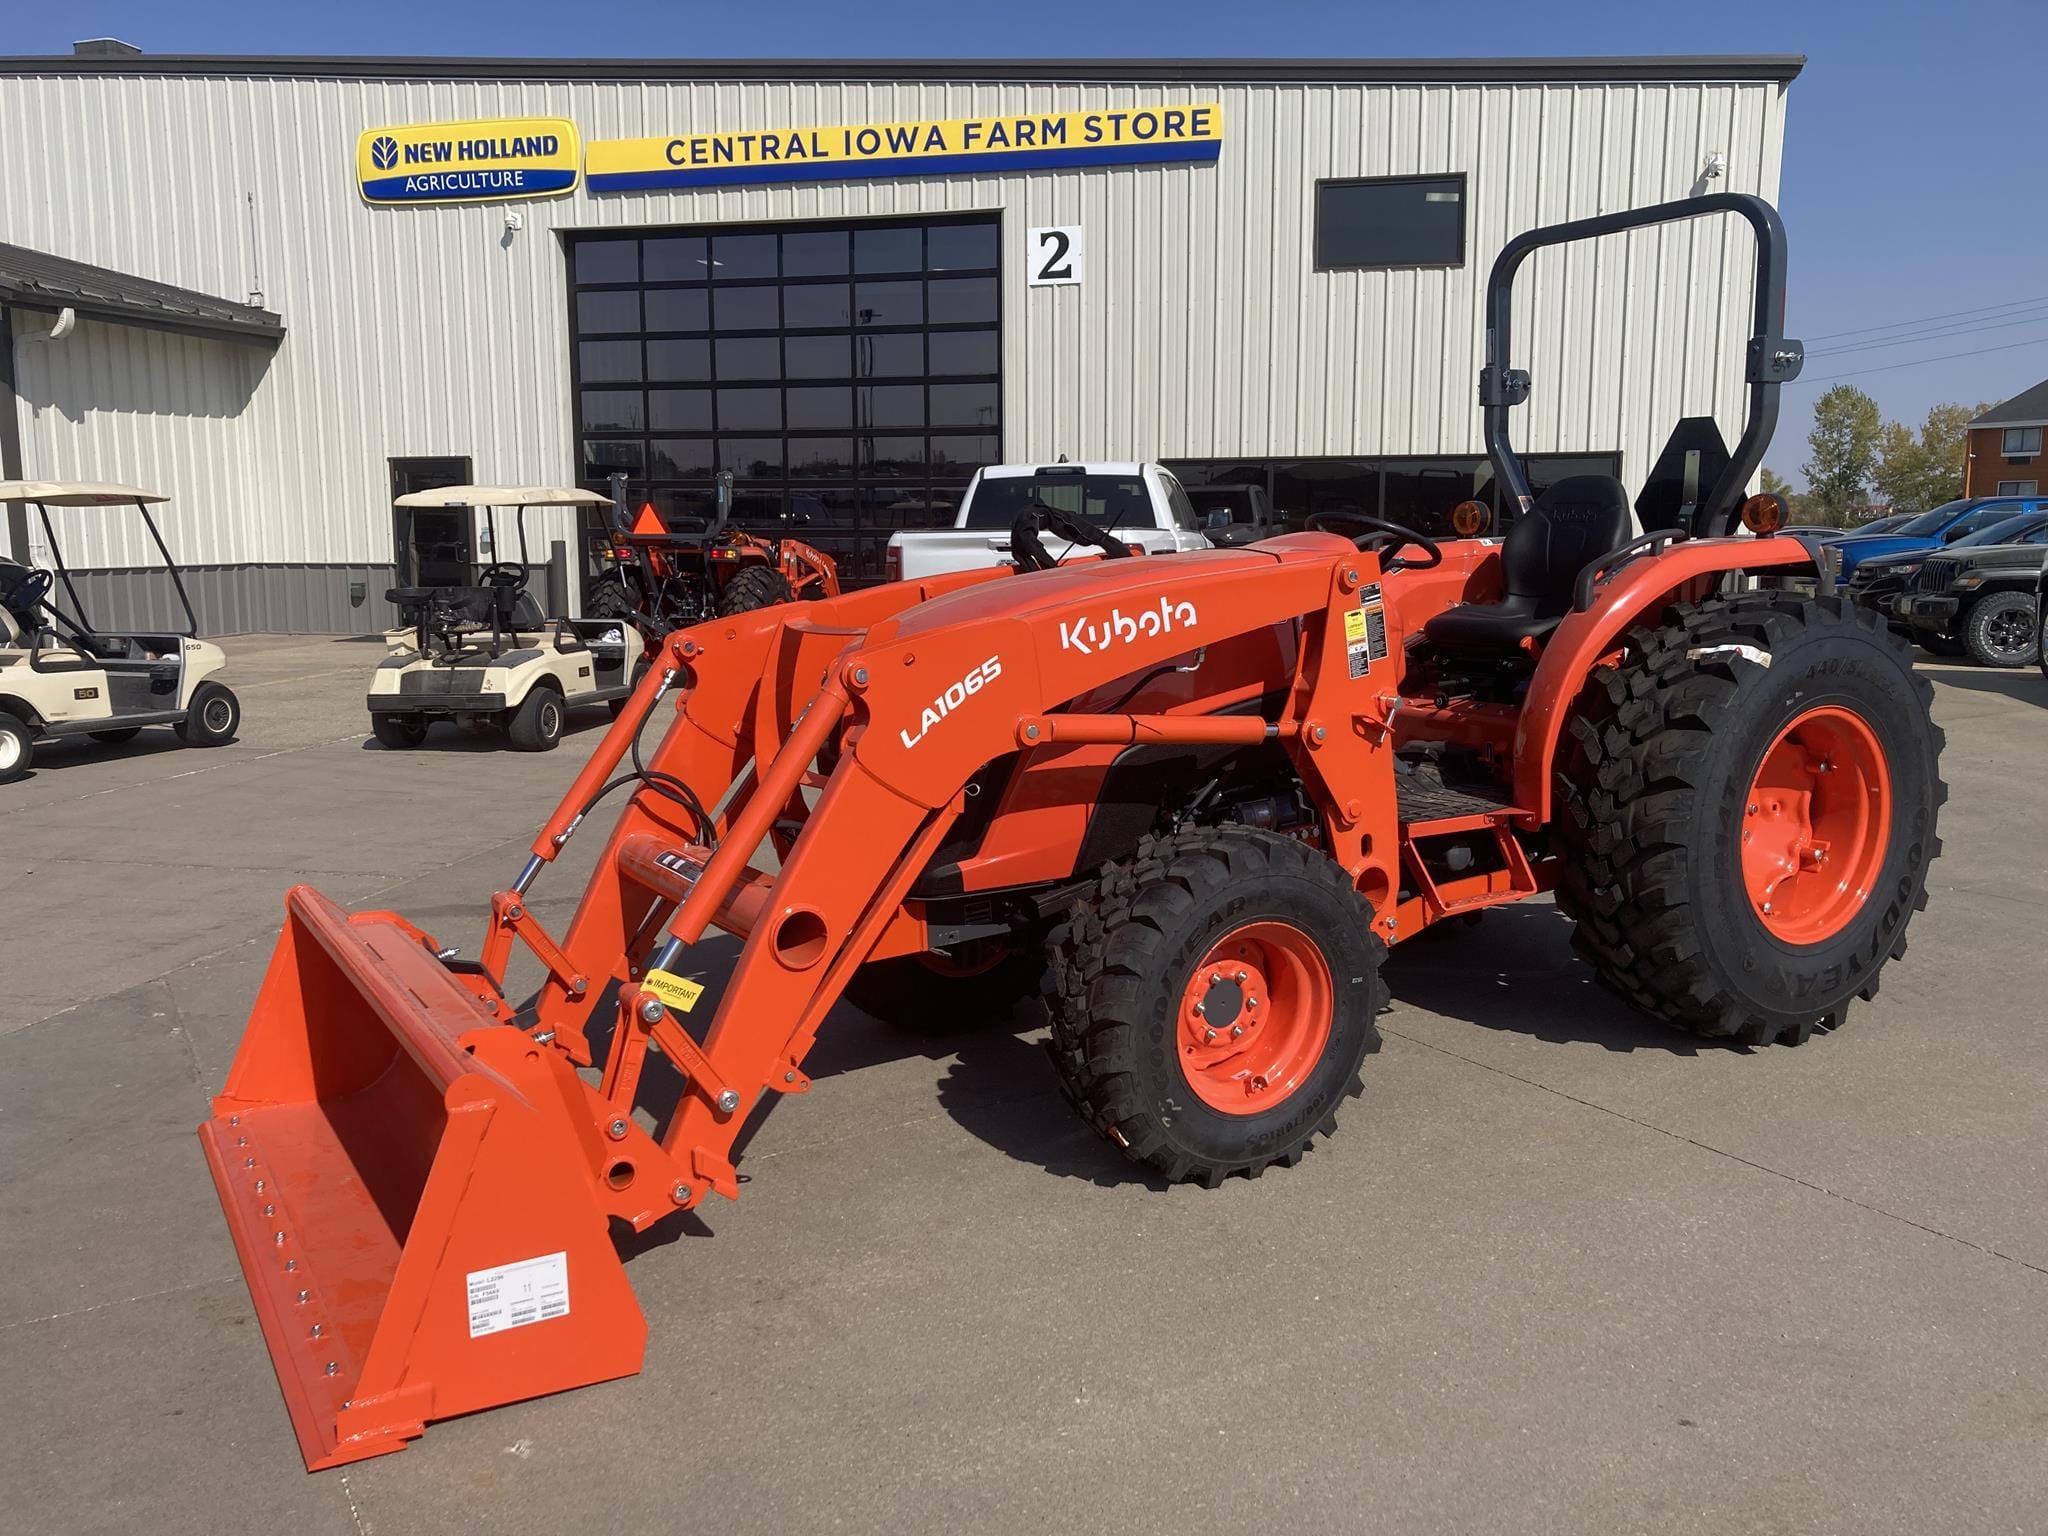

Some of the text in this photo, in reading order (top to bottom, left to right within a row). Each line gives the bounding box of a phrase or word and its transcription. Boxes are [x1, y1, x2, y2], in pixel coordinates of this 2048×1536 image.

[404, 135, 559, 164] NEW HOLLAND
[666, 108, 1212, 166] CENTRAL IOWA FARM STORE
[405, 170, 524, 192] AGRICULTURE
[1038, 230, 1072, 280] 2
[1059, 596, 1198, 655] Kubota
[185, 643, 202, 651] 650
[77, 689, 95, 699] 50
[899, 654, 1003, 750] LA1065
[653, 979, 697, 1001] IMPORTANT
